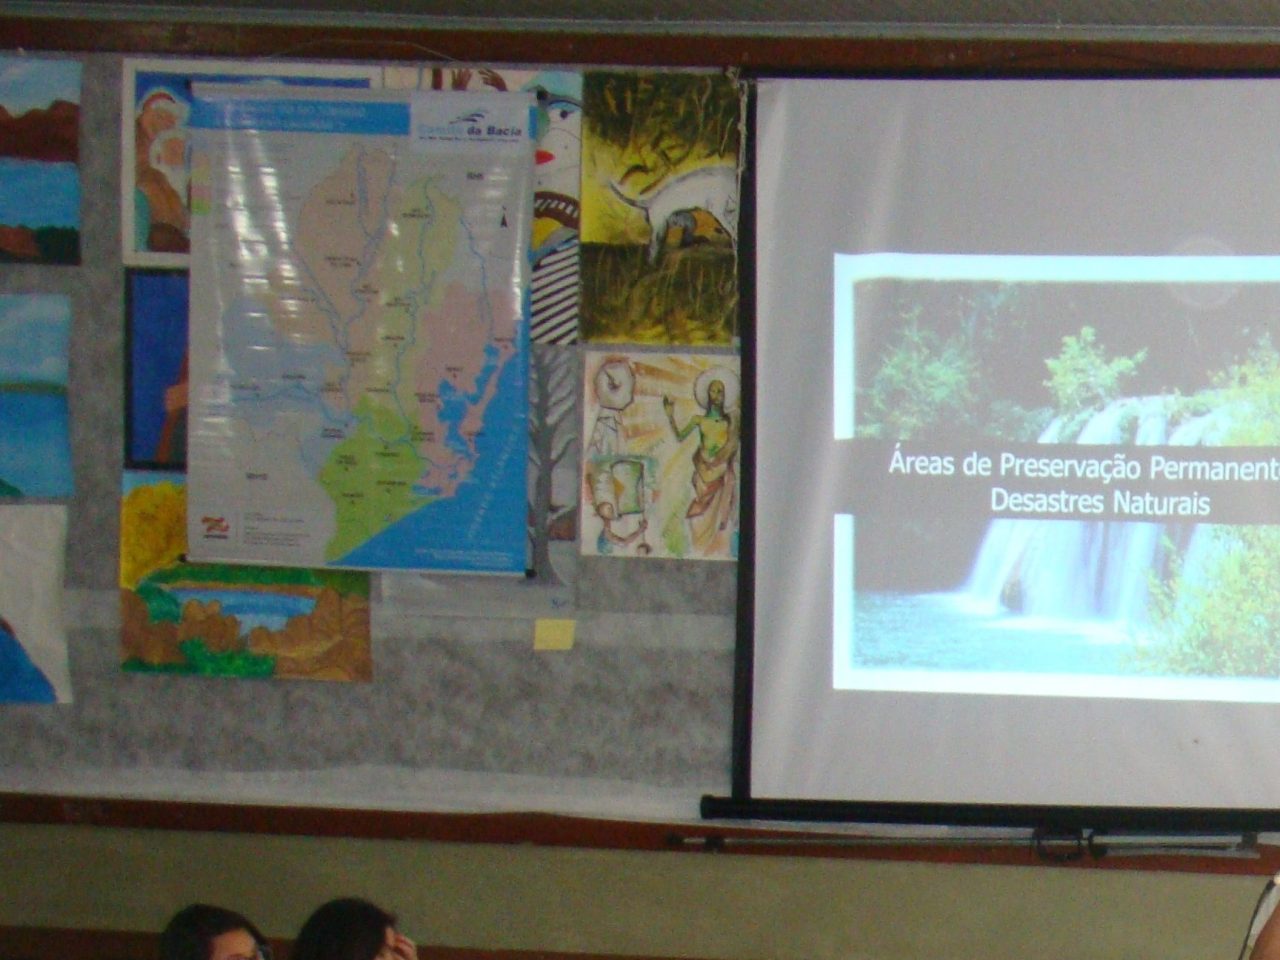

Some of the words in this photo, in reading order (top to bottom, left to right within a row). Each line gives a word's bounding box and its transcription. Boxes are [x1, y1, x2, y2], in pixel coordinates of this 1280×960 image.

[467, 126, 482, 136] da
[487, 125, 523, 136] Bacia
[889, 443, 955, 476] Áreas
[962, 452, 991, 476] de
[1000, 453, 1141, 484] Preservação
[991, 487, 1104, 513] Desastres
[1114, 490, 1210, 516] Naturais
